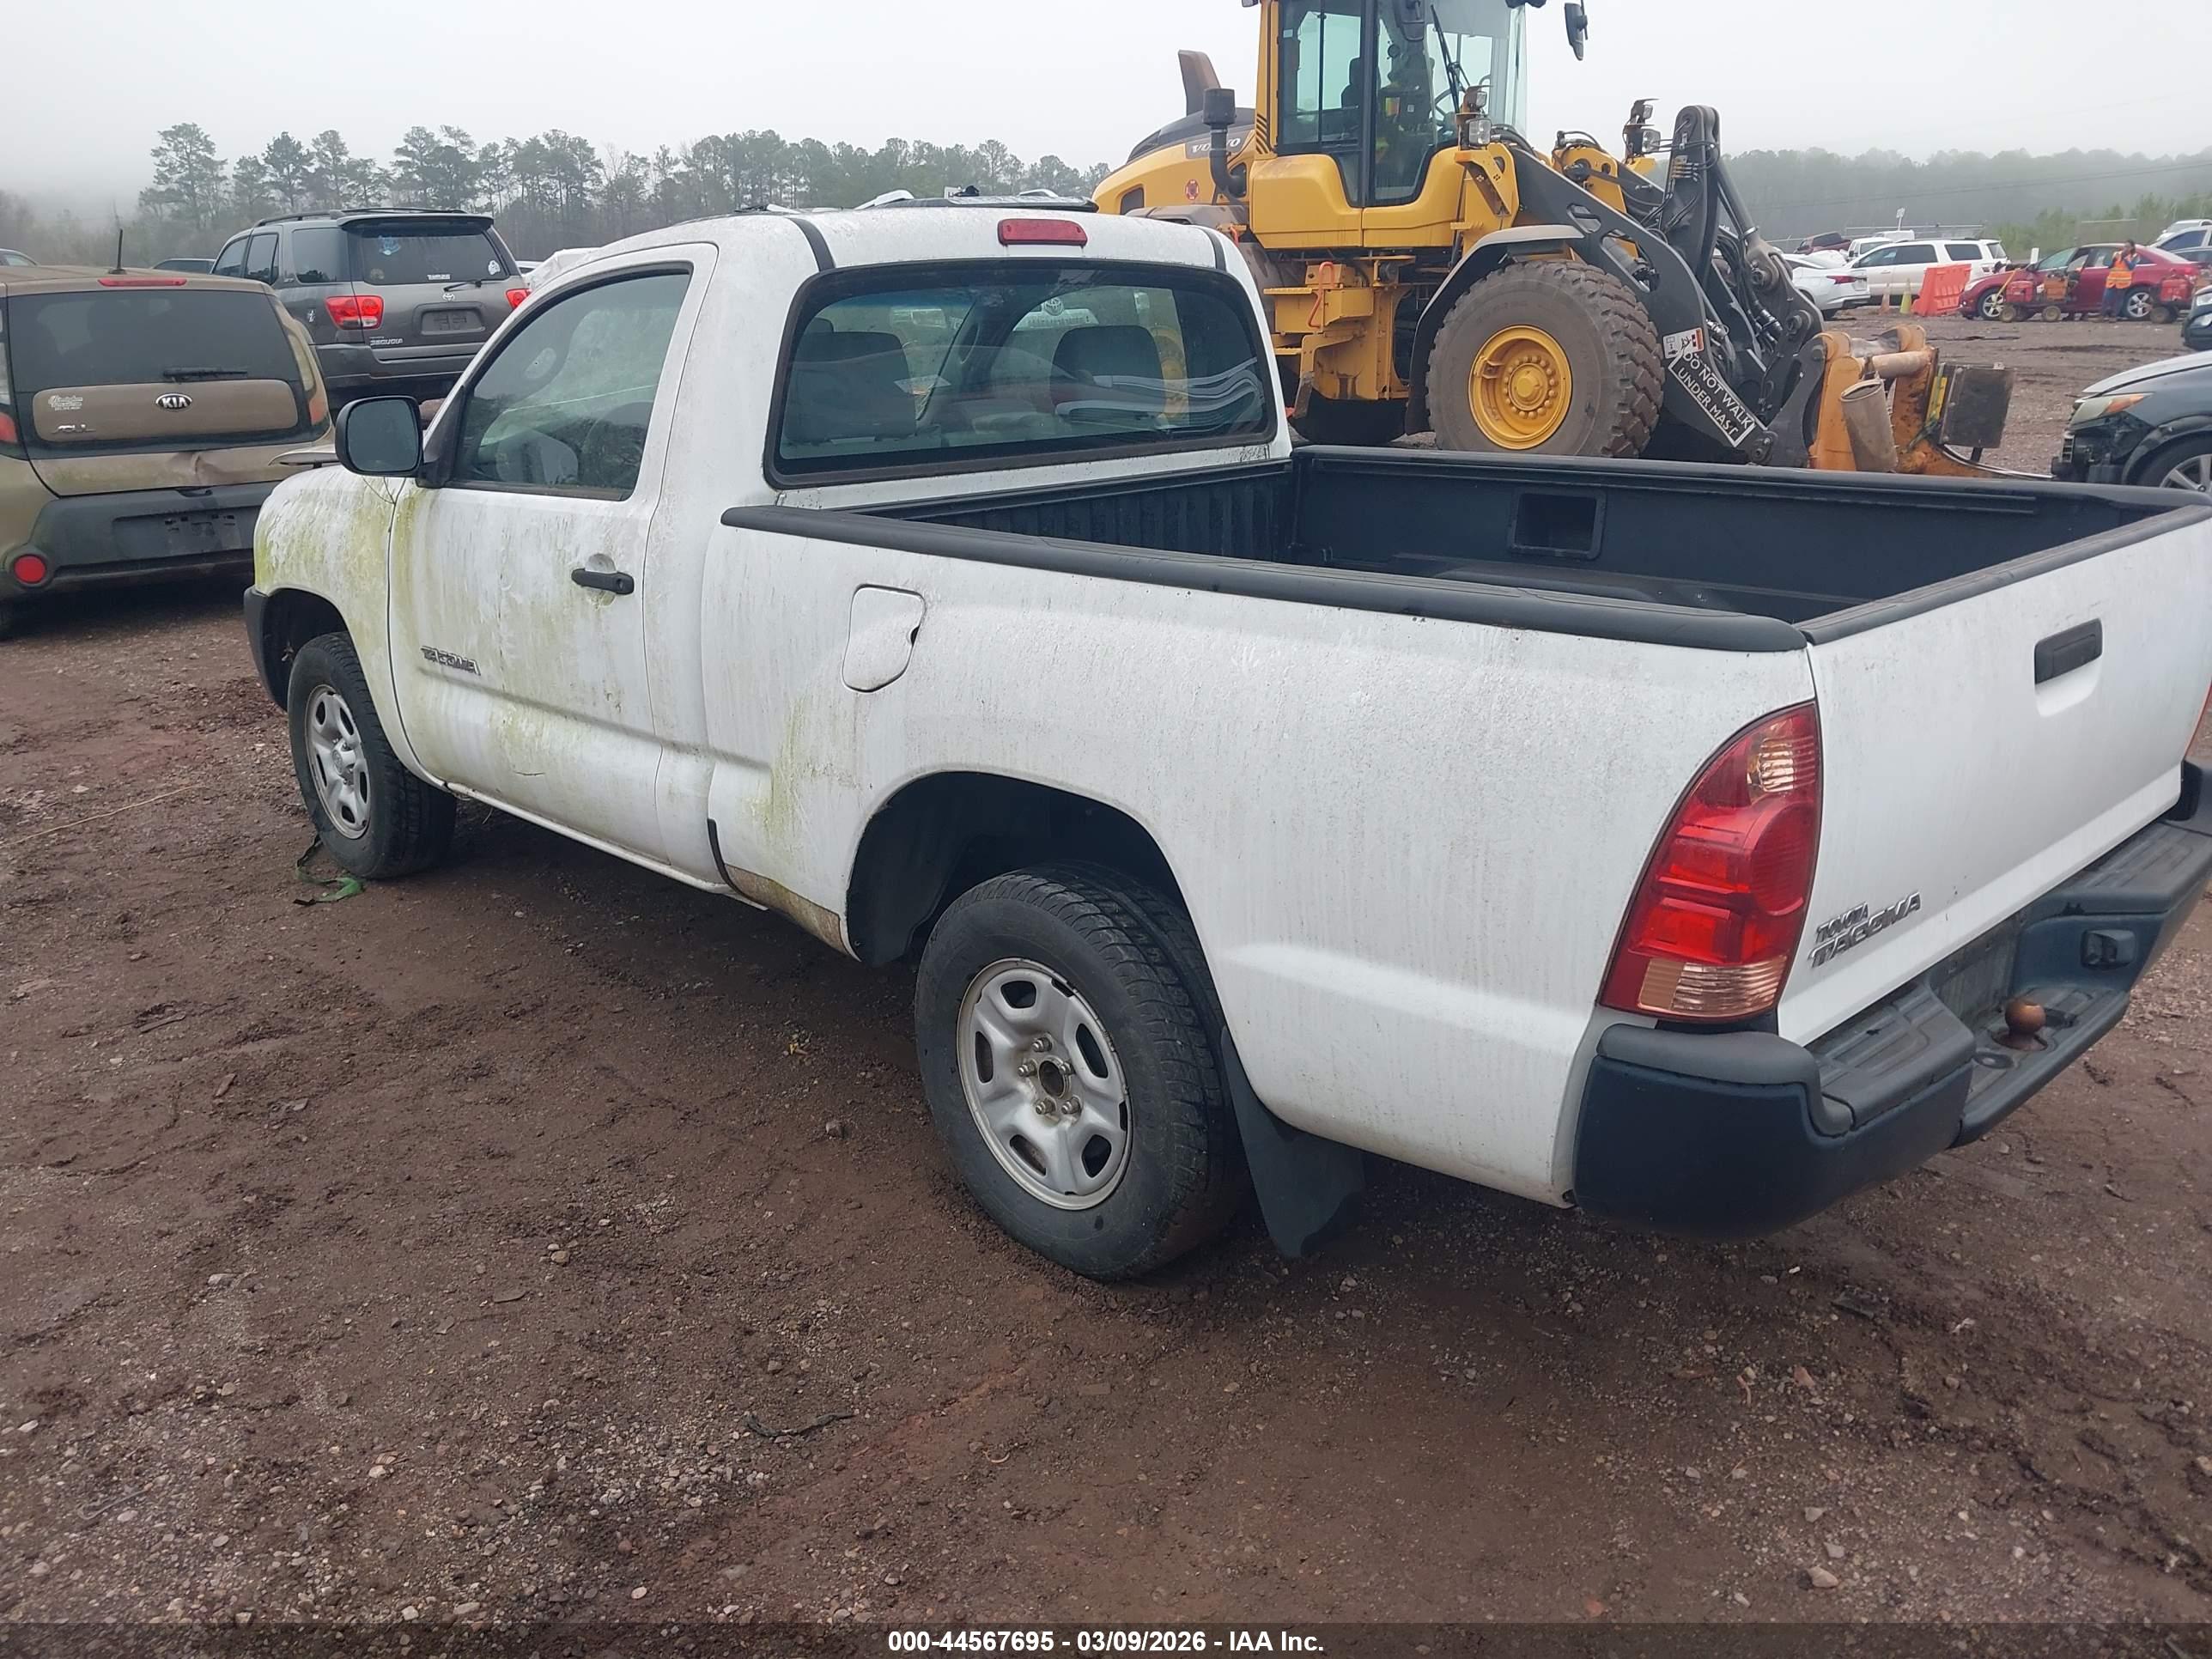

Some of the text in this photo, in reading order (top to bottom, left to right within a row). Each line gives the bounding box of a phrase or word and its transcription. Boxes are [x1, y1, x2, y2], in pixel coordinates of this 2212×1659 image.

[1192, 137, 1241, 153] VOO
[161, 397, 187, 408] KIA
[1678, 368, 1739, 434] UNDER MAST
[1683, 345, 1753, 429] DO NOT WALK
[421, 646, 481, 676] TACOMA
[1808, 892, 1921, 968] TACOMA
[1815, 902, 1869, 944] TOYOTA
